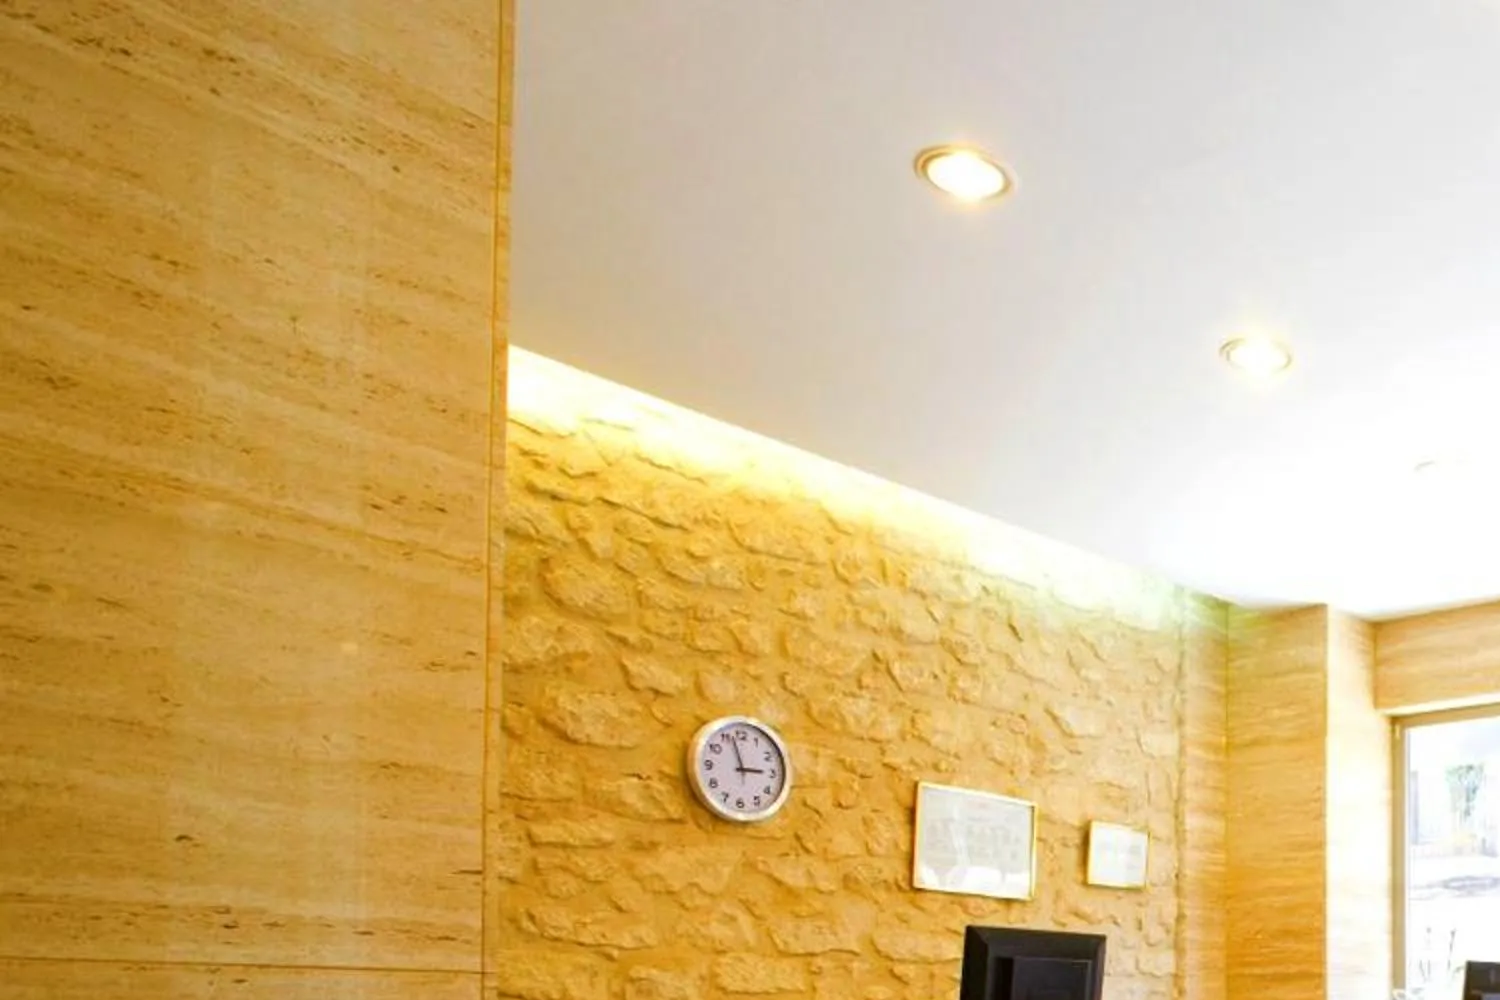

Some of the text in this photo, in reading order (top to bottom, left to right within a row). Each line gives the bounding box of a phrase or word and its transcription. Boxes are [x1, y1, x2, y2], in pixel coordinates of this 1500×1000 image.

[710, 743, 722, 754] 10
[764, 751, 771, 762] 2
[704, 760, 713, 770] 9
[770, 768, 776, 779] 3
[709, 778, 718, 788] 8
[764, 785, 770, 795] 4
[722, 792, 729, 803] 7
[754, 796, 760, 806] 5
[736, 798, 744, 808] 6
